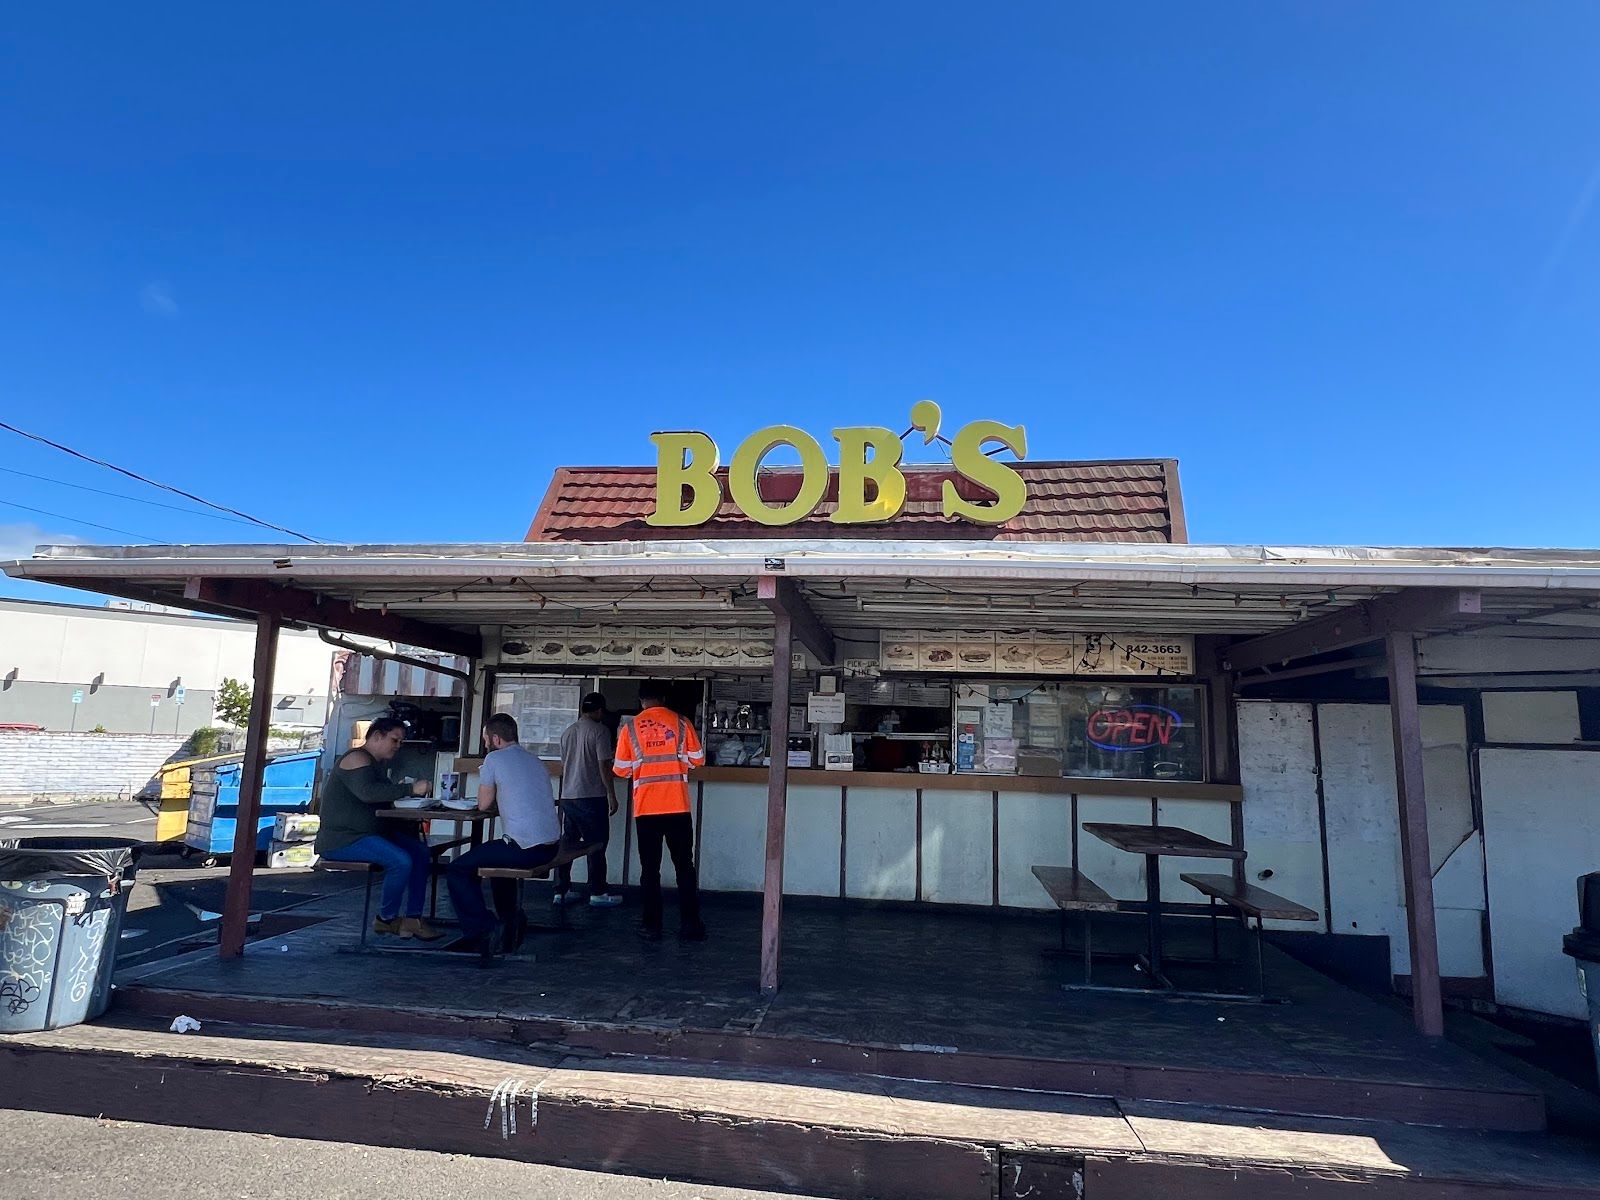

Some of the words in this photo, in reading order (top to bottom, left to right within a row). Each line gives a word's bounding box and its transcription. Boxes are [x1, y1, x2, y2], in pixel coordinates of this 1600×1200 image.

[646, 400, 1027, 526] BOB'S
[1126, 645, 1181, 654] 842-3663
[1087, 709, 1173, 745] OPEN
